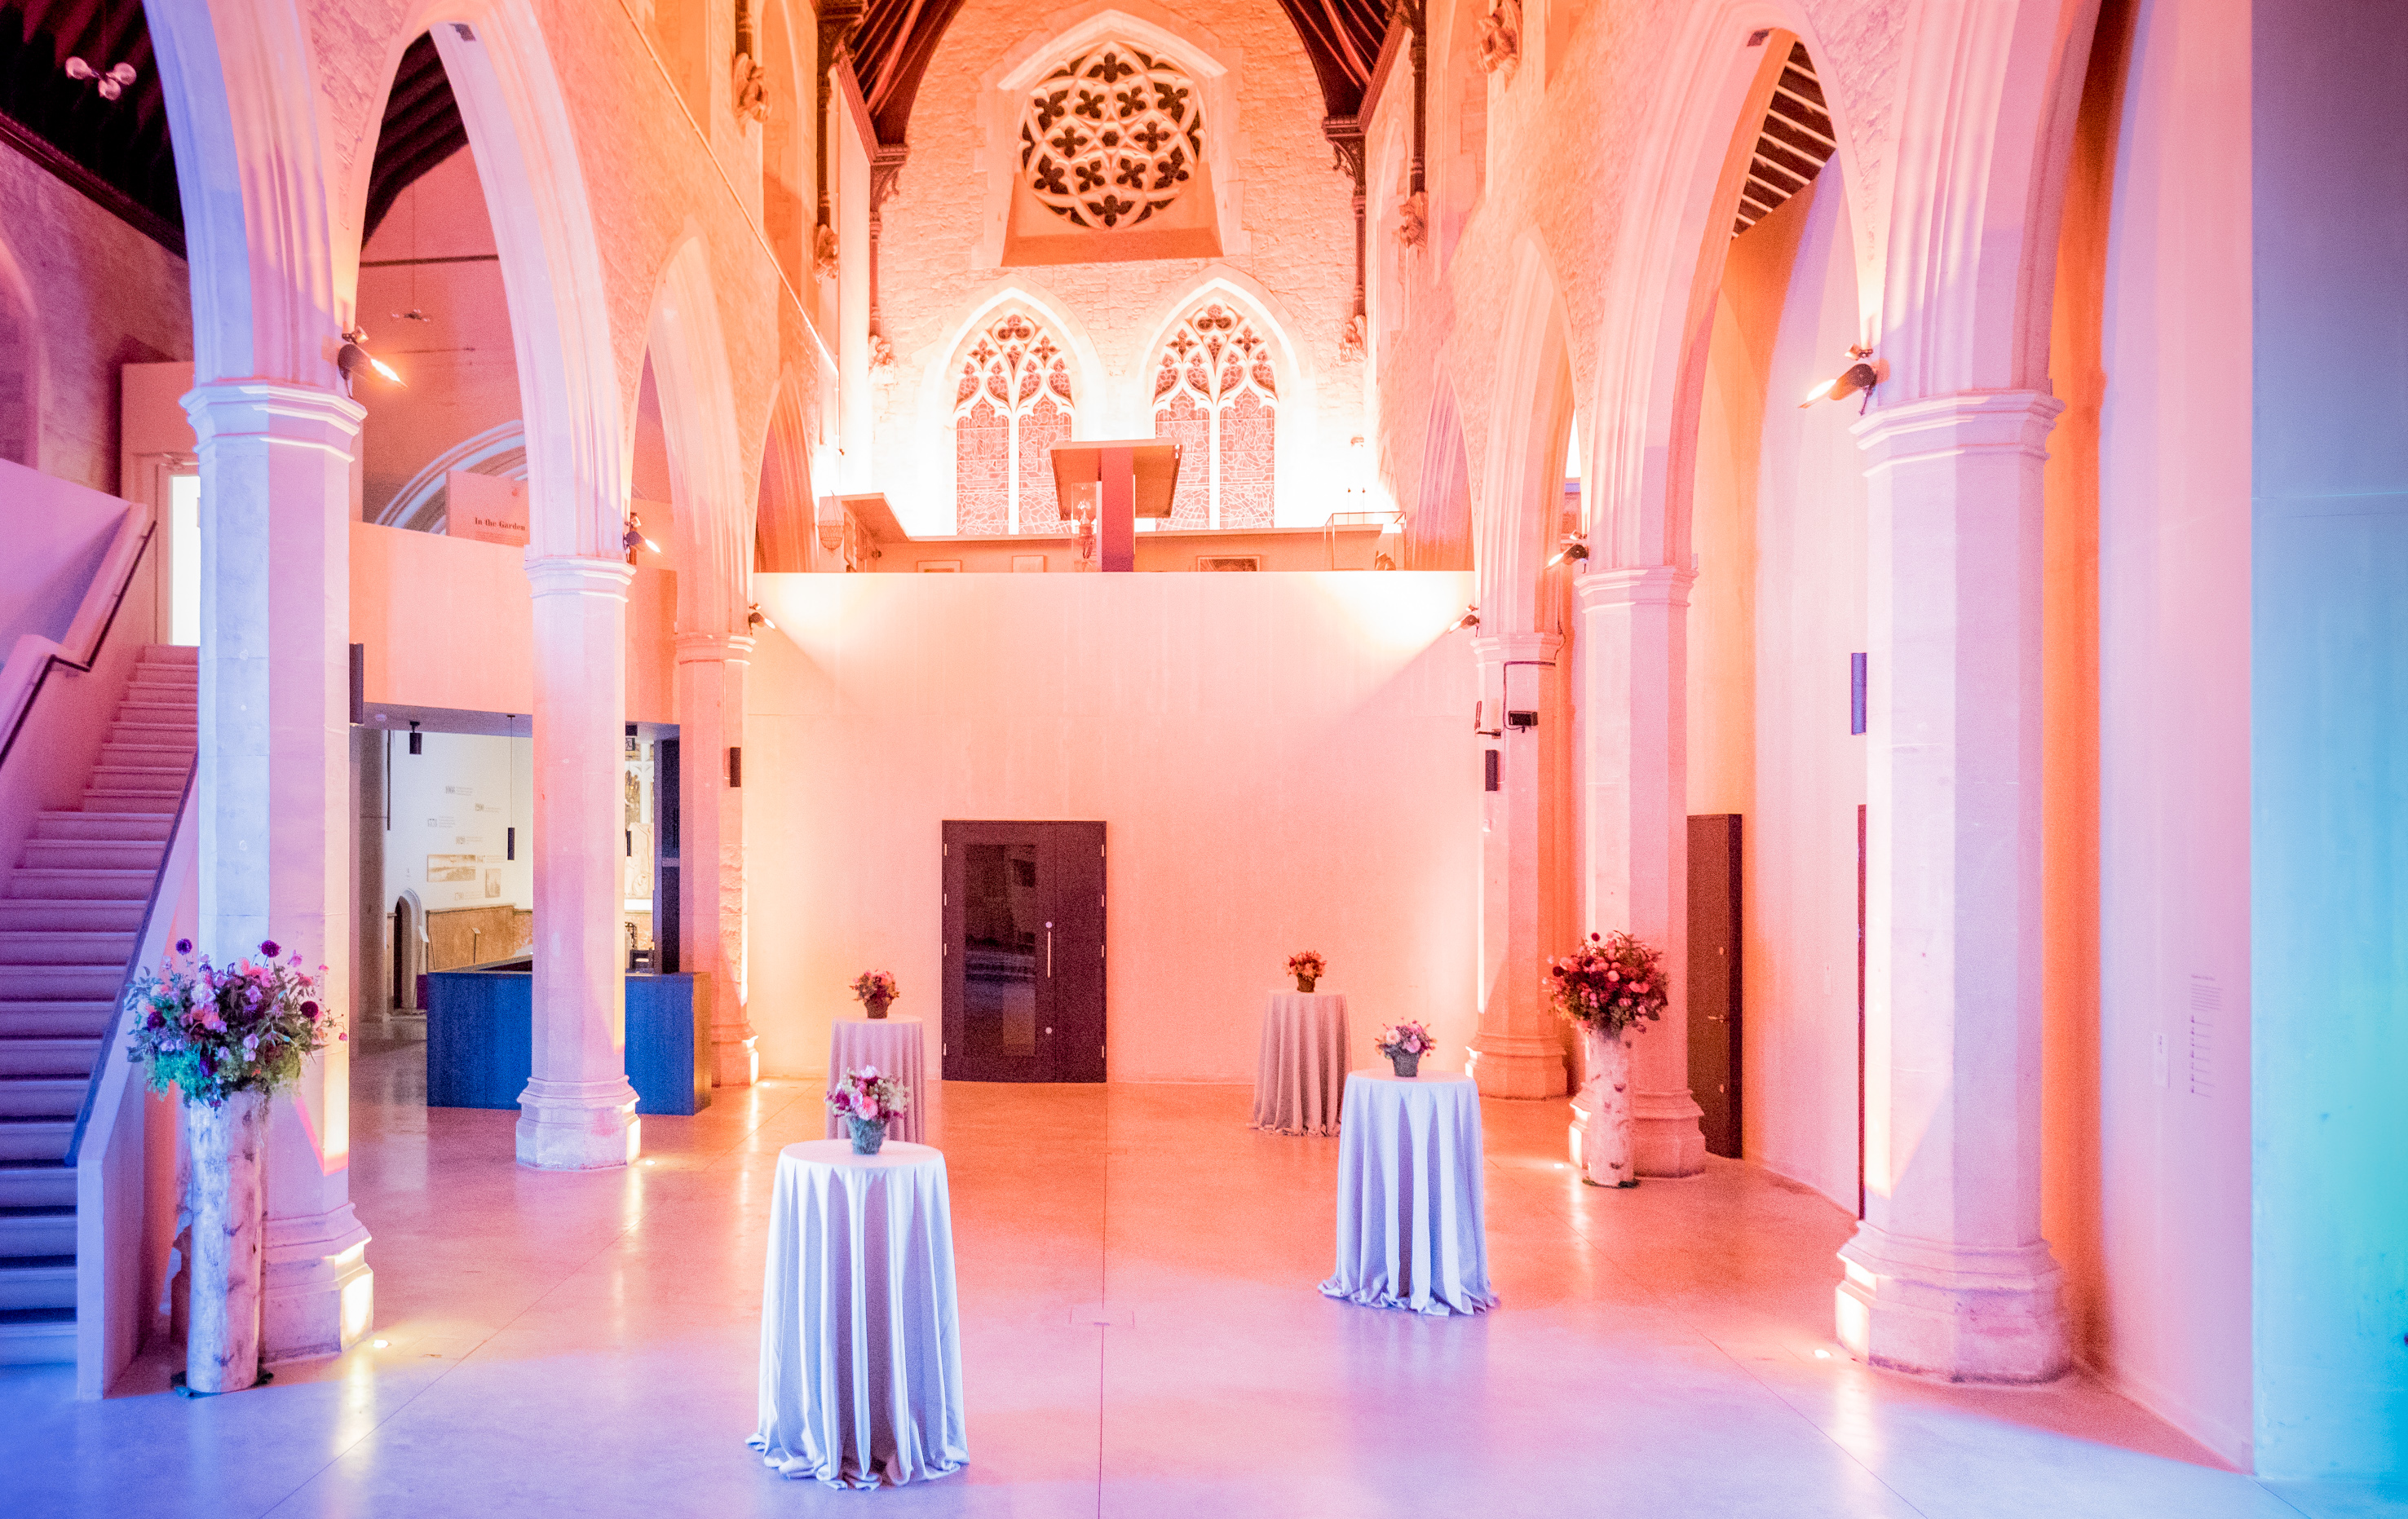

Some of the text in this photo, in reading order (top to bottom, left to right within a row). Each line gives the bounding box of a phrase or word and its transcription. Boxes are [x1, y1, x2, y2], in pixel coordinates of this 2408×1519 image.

[475, 517, 525, 530] In the Garden
